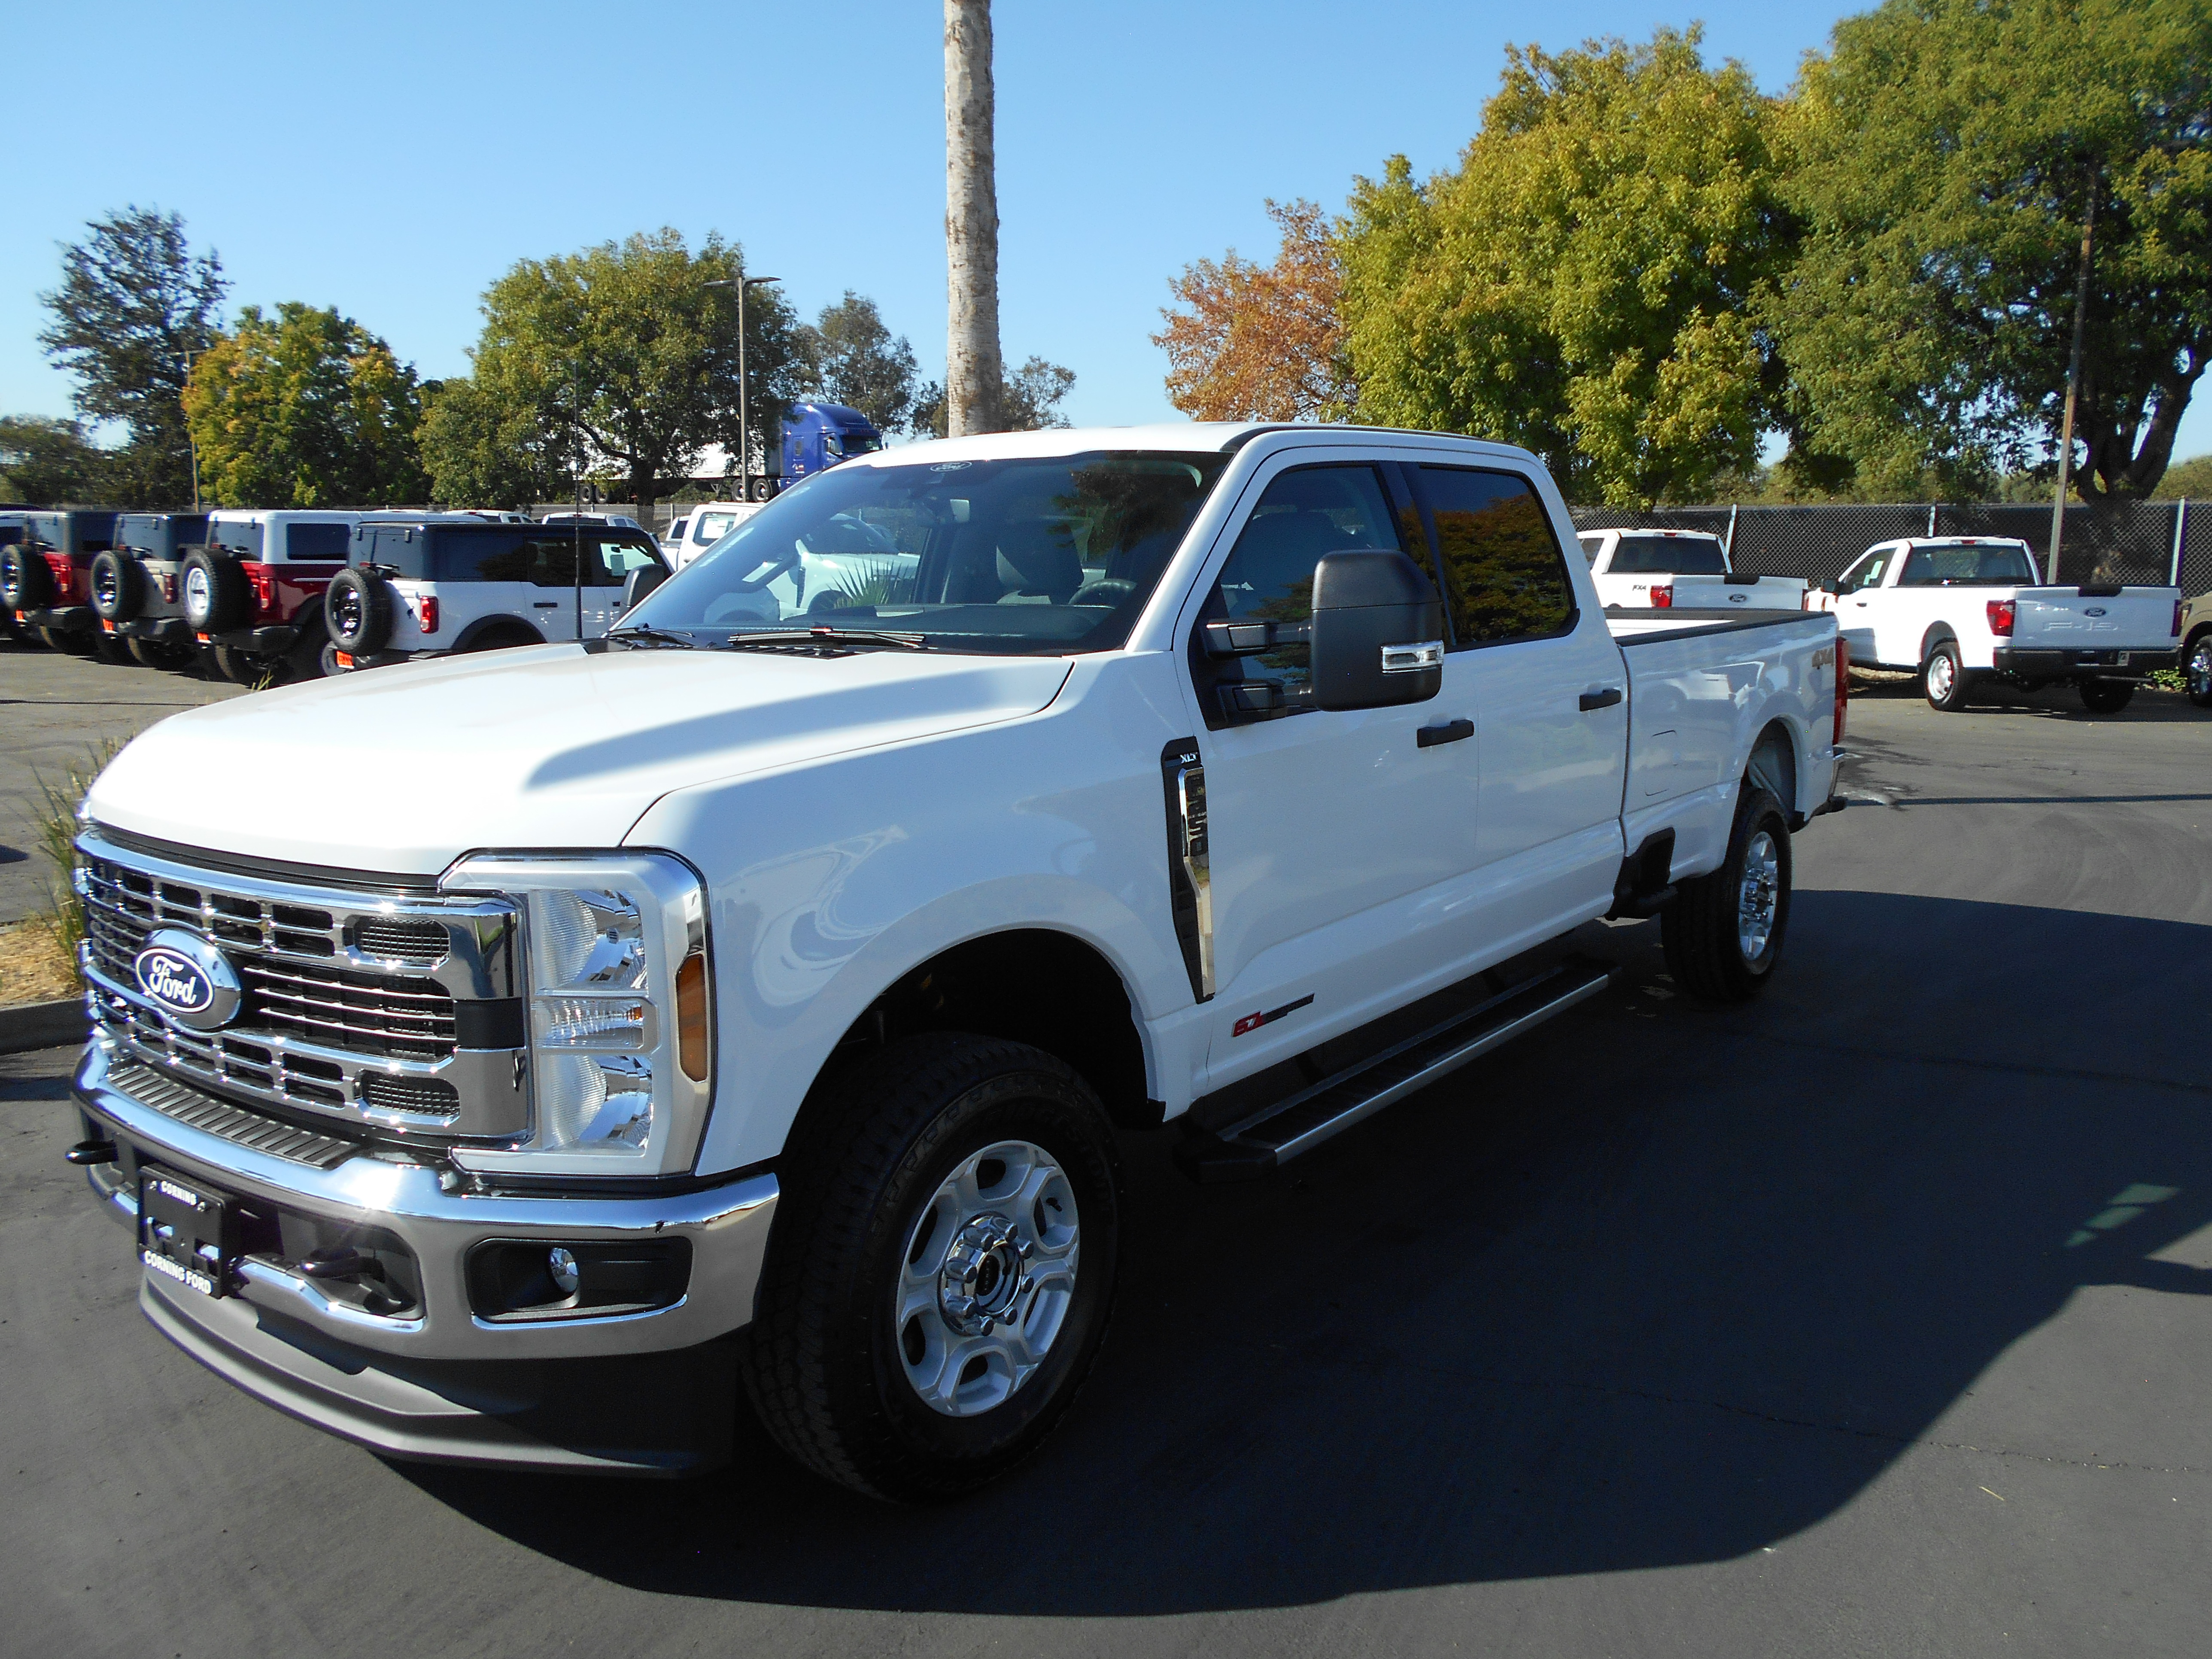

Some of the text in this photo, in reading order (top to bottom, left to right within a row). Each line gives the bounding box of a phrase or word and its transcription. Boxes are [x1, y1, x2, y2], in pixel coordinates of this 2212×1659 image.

[1180, 752, 1198, 763] XLT
[149, 955, 197, 1005] Ford
[161, 1180, 198, 1206] CORNING
[144, 1250, 212, 1294] CORNING FORD
